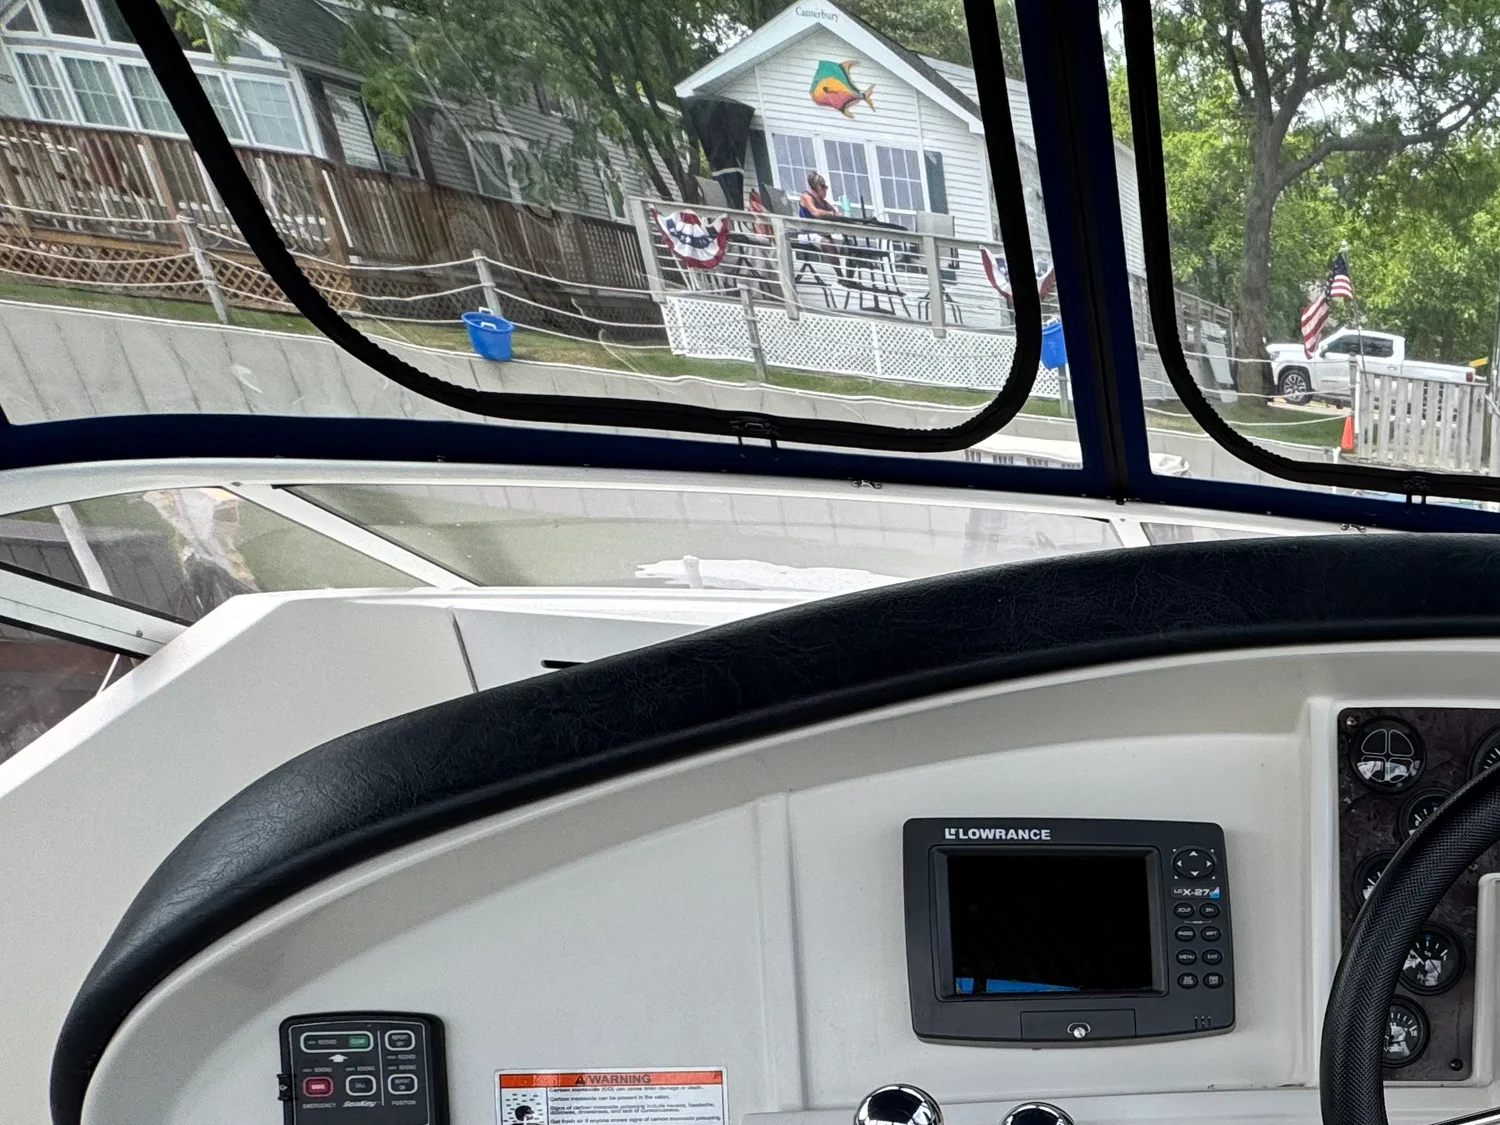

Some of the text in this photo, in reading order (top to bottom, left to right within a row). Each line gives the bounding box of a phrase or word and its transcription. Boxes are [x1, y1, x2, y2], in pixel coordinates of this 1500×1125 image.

[796, 6, 839, 23] Canterbury
[959, 828, 1051, 840] LOWRANCE
[588, 1074, 651, 1085] WARNING
